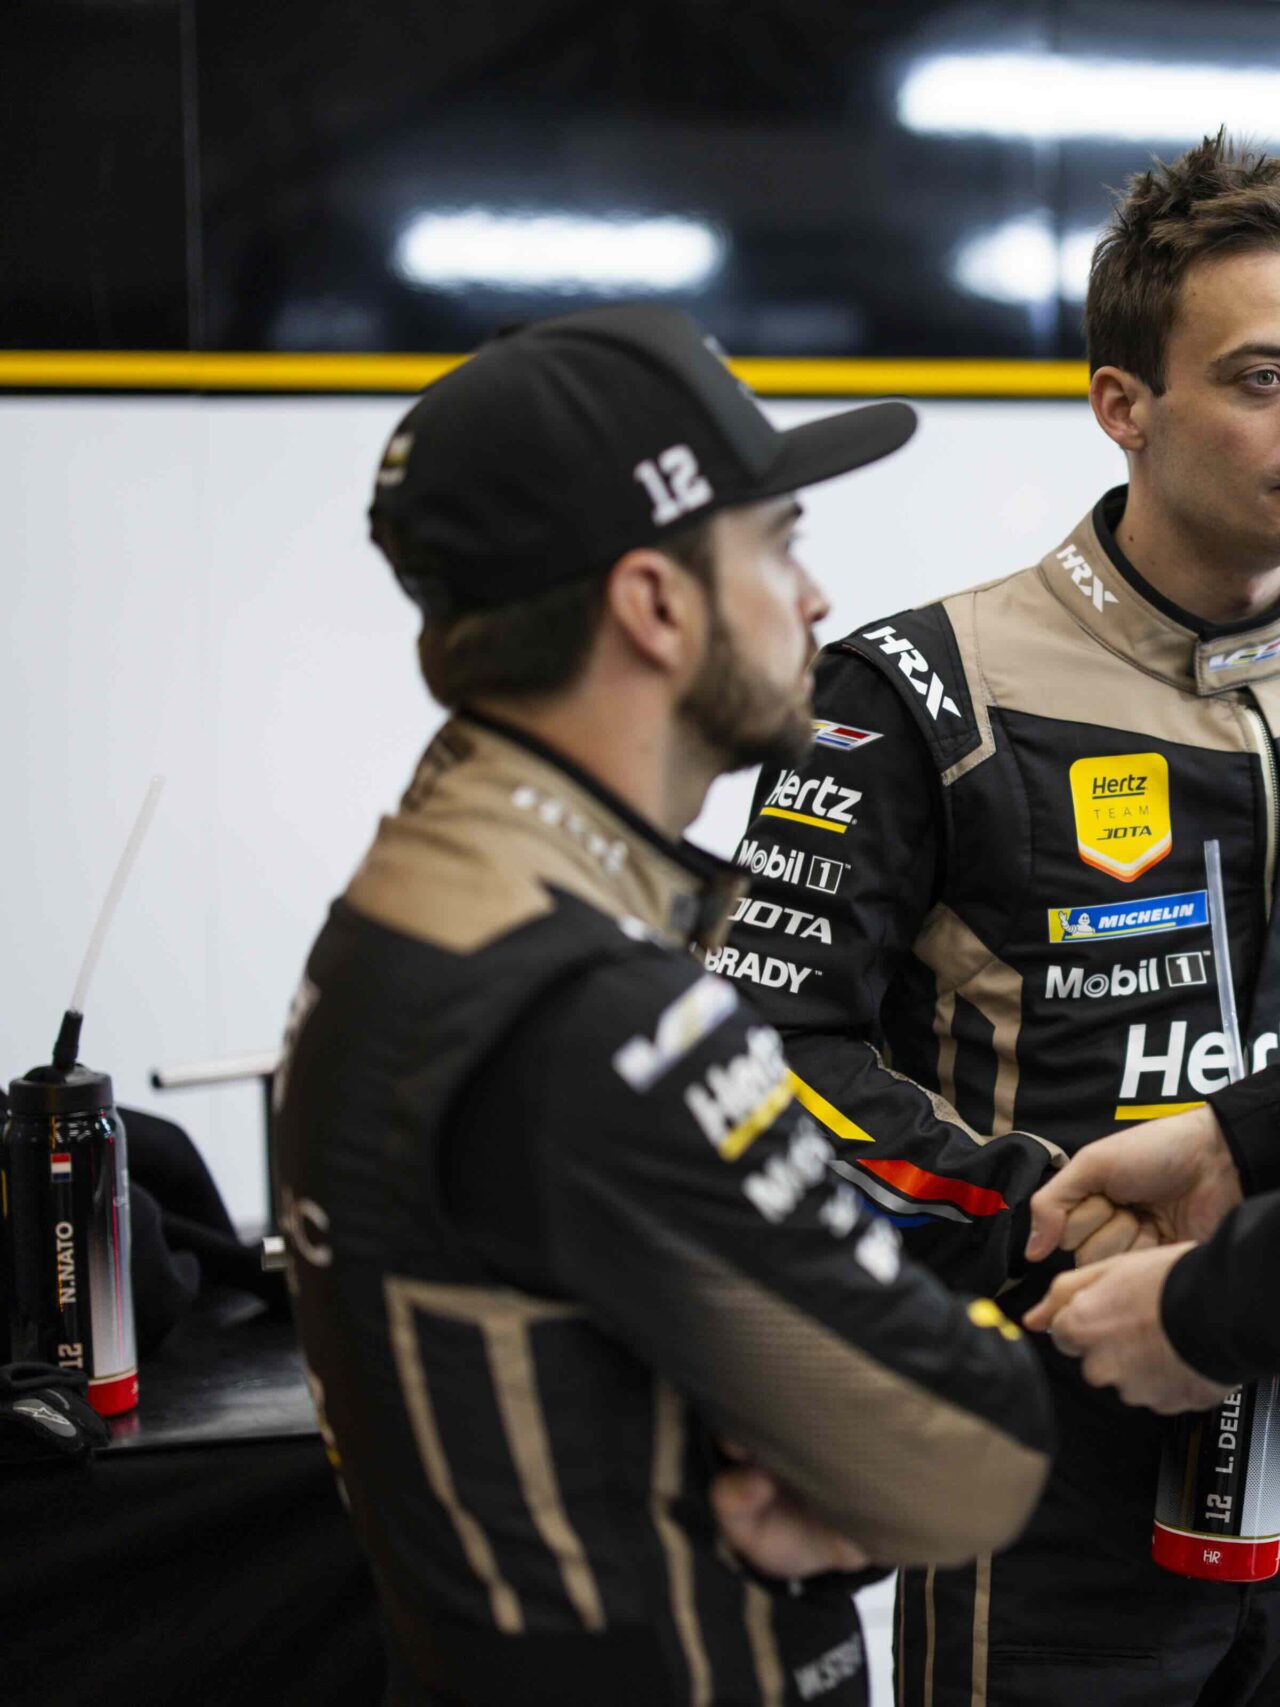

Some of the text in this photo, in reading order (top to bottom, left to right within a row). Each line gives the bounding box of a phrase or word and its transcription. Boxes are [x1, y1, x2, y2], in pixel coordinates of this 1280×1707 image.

[633, 444, 714, 526] 12
[1056, 544, 1119, 613] HRX
[863, 625, 962, 721] HRX
[765, 769, 862, 823] Hertz
[1092, 774, 1147, 794] Hertz
[1094, 806, 1149, 820] TEAM
[1096, 825, 1152, 840] JOTA
[737, 839, 805, 884] Mobil
[1098, 903, 1195, 929] MICHELIN
[705, 946, 811, 994] BRADY
[1045, 958, 1160, 998] Mobil
[58, 1342, 83, 1369] 12
[1215, 1456, 1234, 1474] L.
[1205, 1493, 1232, 1523] 12
